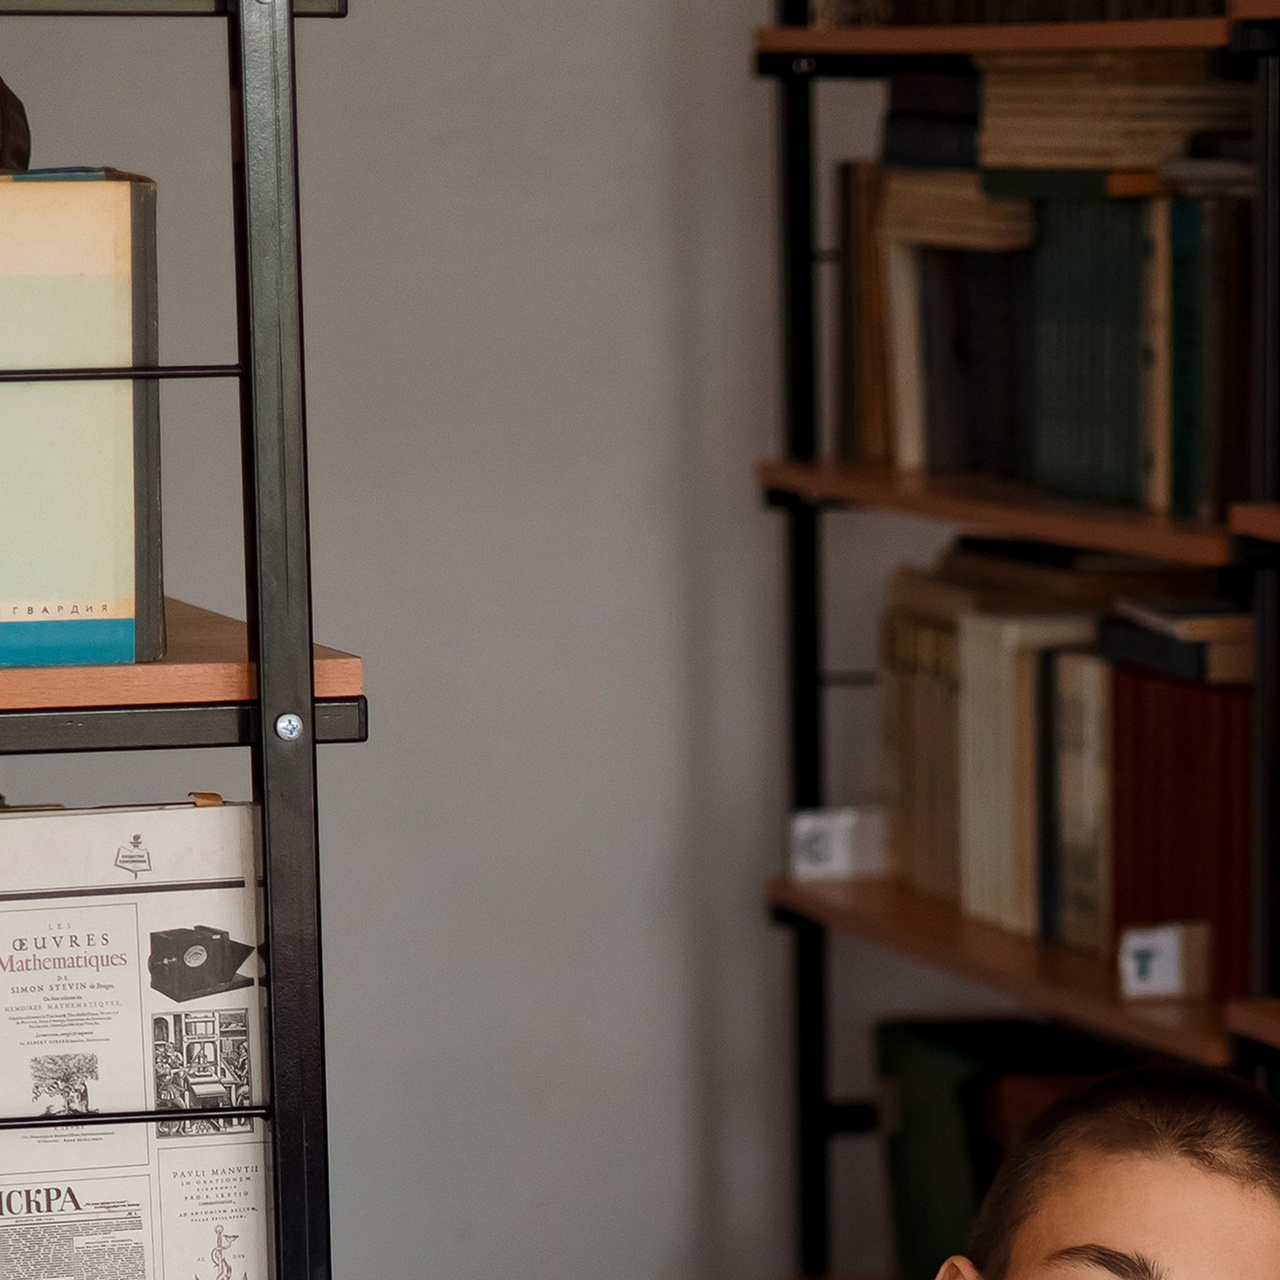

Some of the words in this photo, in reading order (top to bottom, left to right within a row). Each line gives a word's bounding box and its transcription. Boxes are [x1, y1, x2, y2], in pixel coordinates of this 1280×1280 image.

[12, 604, 108, 615] ГВАРДИЯ
[48, 923, 72, 931] LES
[12, 933, 110, 951] ŒUVRES
[0, 951, 128, 972] Mathematiques
[10, 985, 45, 994] SIMON
[49, 982, 87, 992] STEVIN
[172, 1170, 205, 1178] PAVLI
[211, 1165, 258, 1176] MANVTII
